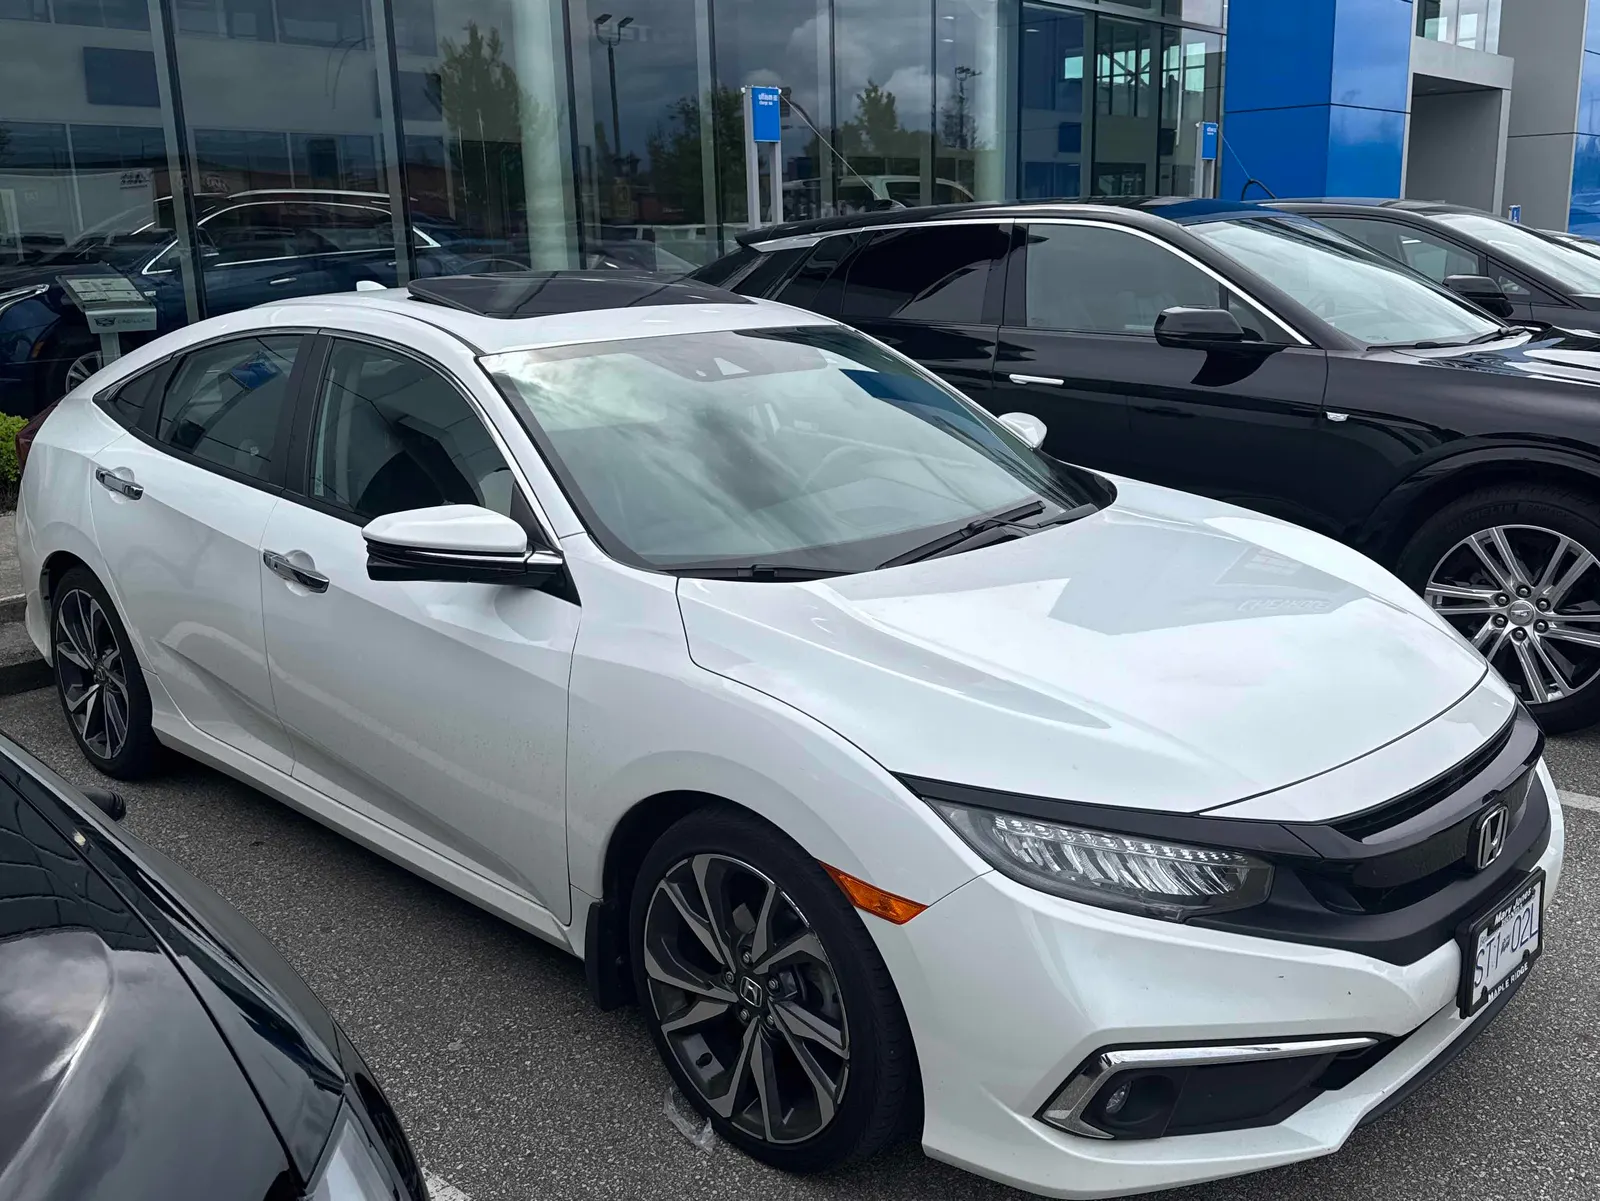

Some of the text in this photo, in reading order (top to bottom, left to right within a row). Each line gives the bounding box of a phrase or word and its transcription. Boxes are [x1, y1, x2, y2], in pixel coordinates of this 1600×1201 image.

[1510, 902, 1539, 953] 02L
[1487, 961, 1529, 1003] MAPLE RIDGE
